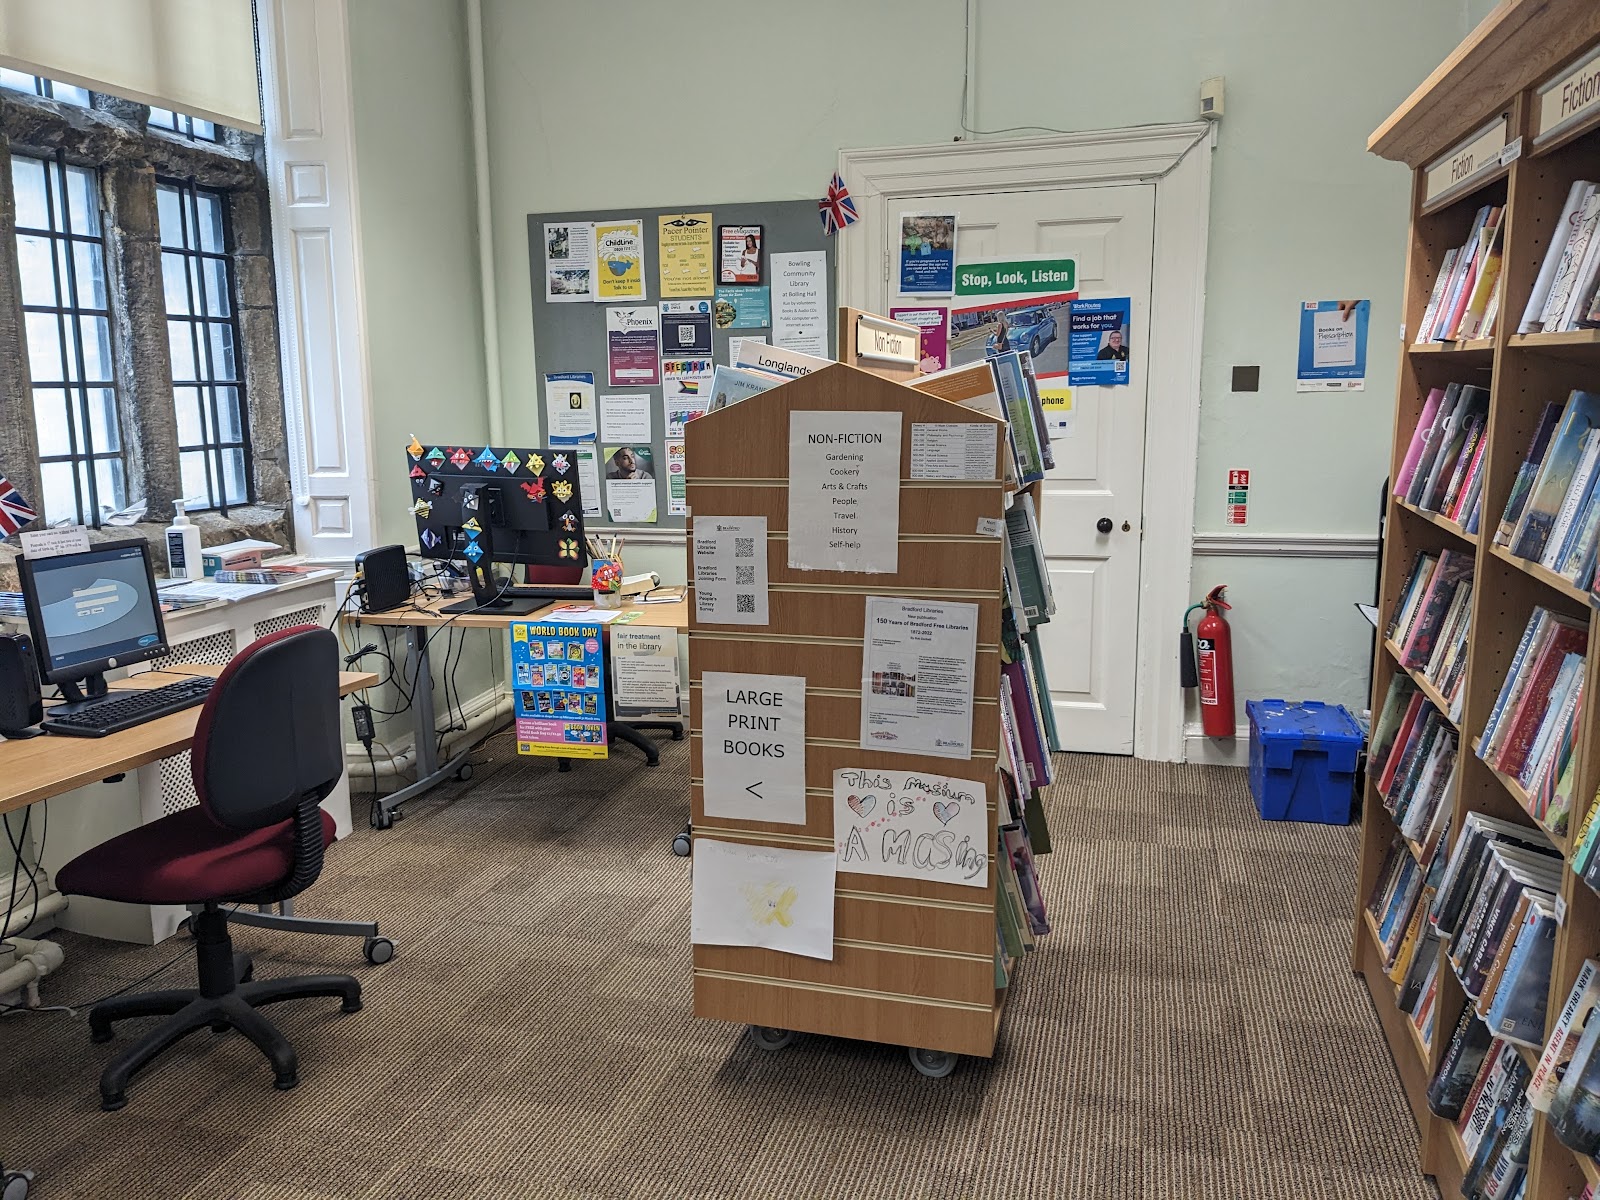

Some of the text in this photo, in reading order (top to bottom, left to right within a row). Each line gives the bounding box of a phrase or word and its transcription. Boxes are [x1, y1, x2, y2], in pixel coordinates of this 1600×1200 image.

[1451, 153, 1474, 183] Fiction
[1568, 210, 1583, 246] SWITCH
[962, 270, 1068, 287] Stop, Look, Listen
[875, 330, 902, 355] Non Fiction
[1317, 331, 1353, 340] Prescription
[665, 361, 711, 371] SPECTRUM
[758, 355, 812, 376] Longlands
[808, 433, 882, 444] NON-FICTION
[826, 454, 864, 462] Gardening
[829, 468, 860, 477] Cookery
[832, 498, 858, 506] People
[1560, 474, 1585, 528] LULU TAYLOR
[832, 526, 858, 535] History
[829, 541, 861, 550] Self-help
[529, 626, 598, 637] WORLD BOOK DAY
[640, 643, 662, 651] library
[1510, 618, 1538, 674] MINETTE
[726, 689, 783, 707] LARGE
[728, 714, 781, 731] PRINT
[1486, 707, 1502, 737] LAST
[1556, 700, 1574, 742] PERSUASION
[724, 739, 785, 758] BOOKS
[1409, 756, 1417, 778] TREE
[841, 770, 892, 790] This
[886, 792, 915, 817] is
[1435, 820, 1450, 855] EAGLES
[1467, 902, 1489, 954] KAREN ROSE
[1472, 908, 1500, 970] VINCE CABLE
[1482, 922, 1516, 996] PHILIPPA GREGORY
[1532, 966, 1592, 1091] MARK GREANEY AGENT IN PLACE
[1440, 1038, 1461, 1082] CAST IRON
[1503, 1073, 1518, 1103] JAMES
[1501, 1088, 1524, 1134] PATTERSON
[1507, 1102, 1522, 1131] JAMES
[1513, 1116, 1528, 1145] JAMES
